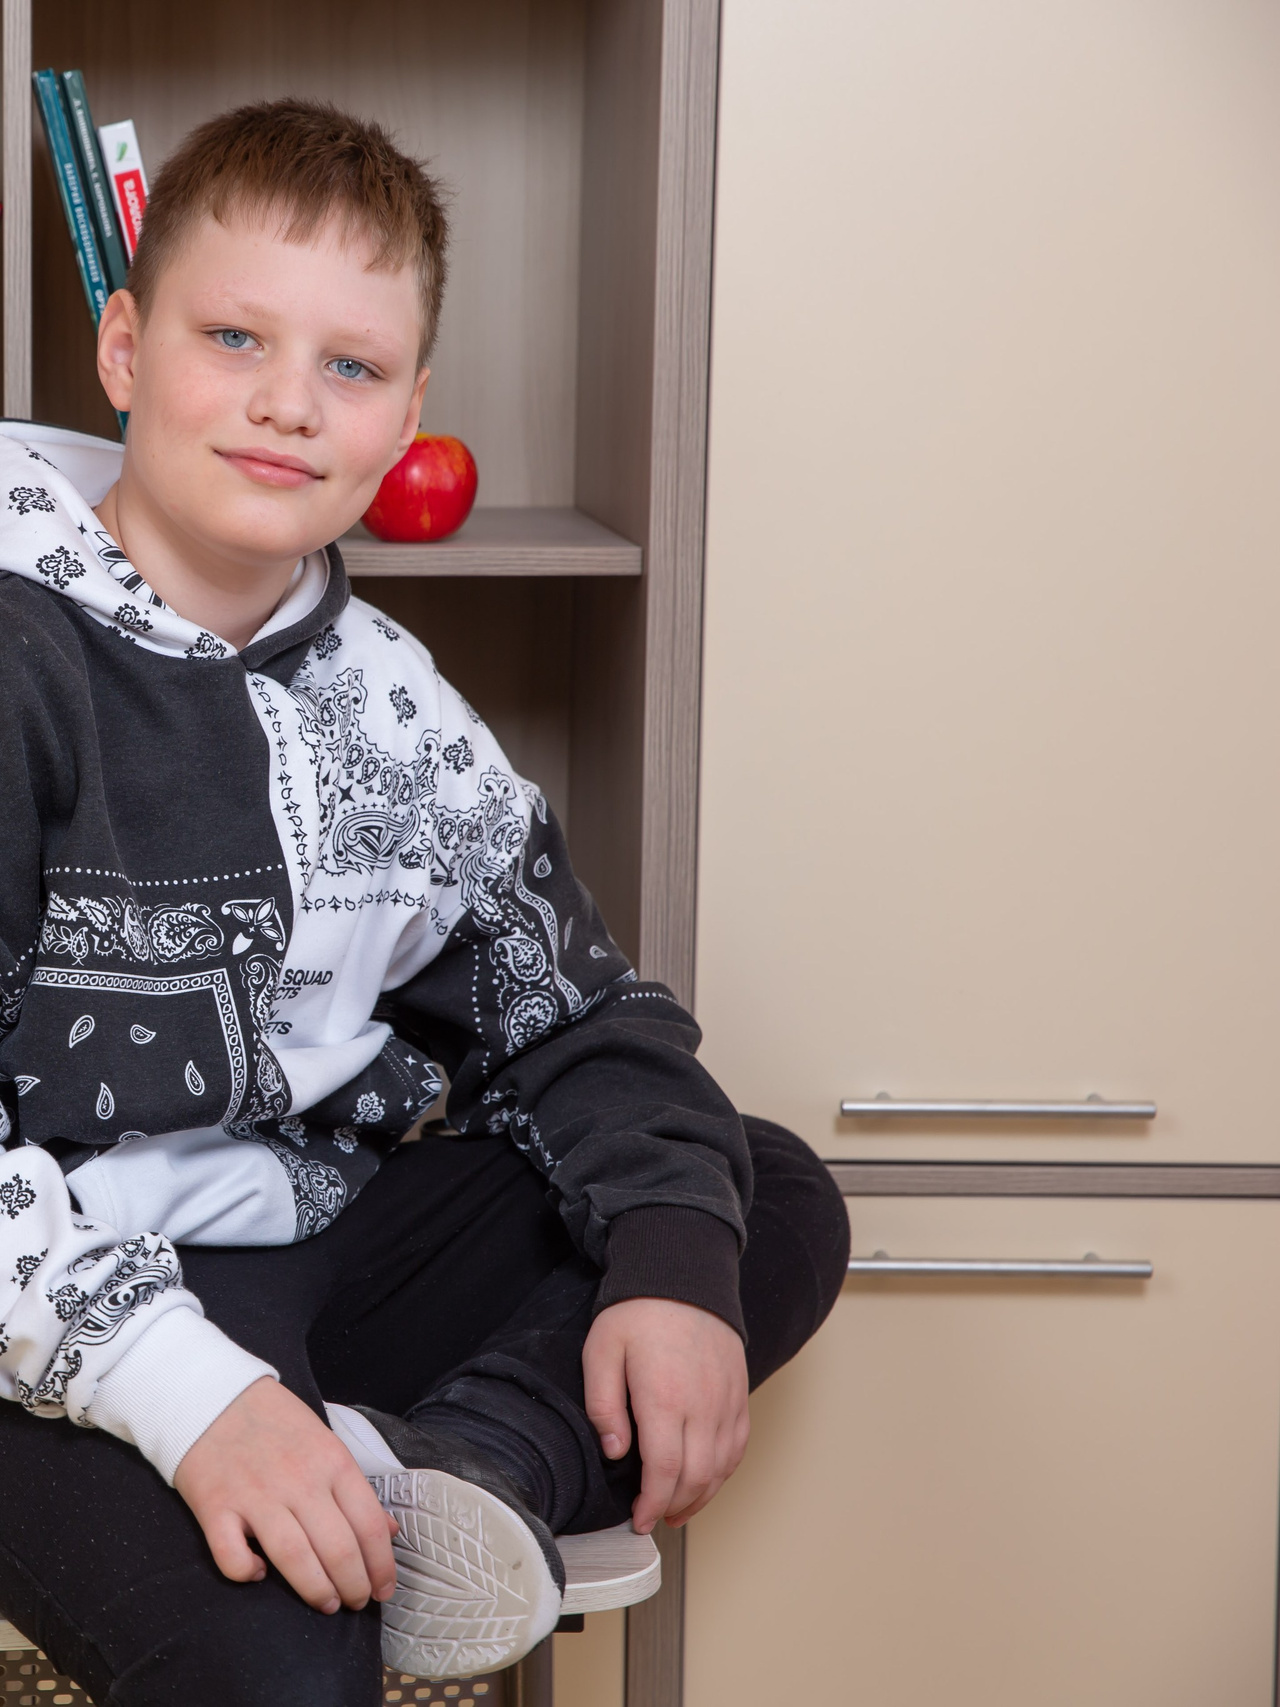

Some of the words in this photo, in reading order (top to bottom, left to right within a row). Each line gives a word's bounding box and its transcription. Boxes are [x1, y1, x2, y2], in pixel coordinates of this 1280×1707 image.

[283, 968, 333, 985] SQUAD
[273, 986, 302, 1001] CTS
[264, 1021, 293, 1035] ETS
